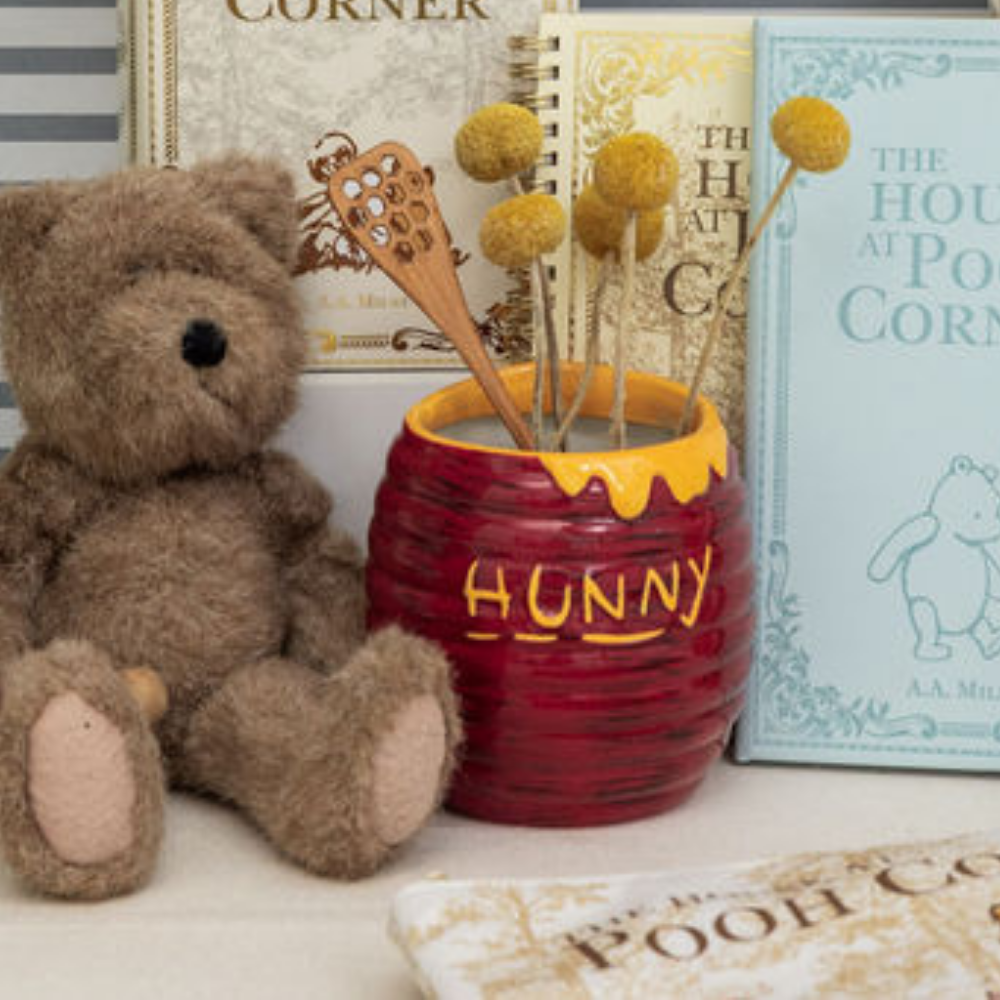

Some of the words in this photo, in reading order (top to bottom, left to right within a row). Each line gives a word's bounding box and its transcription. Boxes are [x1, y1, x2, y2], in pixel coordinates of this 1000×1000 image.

[697, 125, 750, 150] TH
[870, 147, 949, 173] THE
[857, 233, 902, 258] AT
[464, 545, 712, 628] HUNNY
[565, 888, 852, 970] POOH
